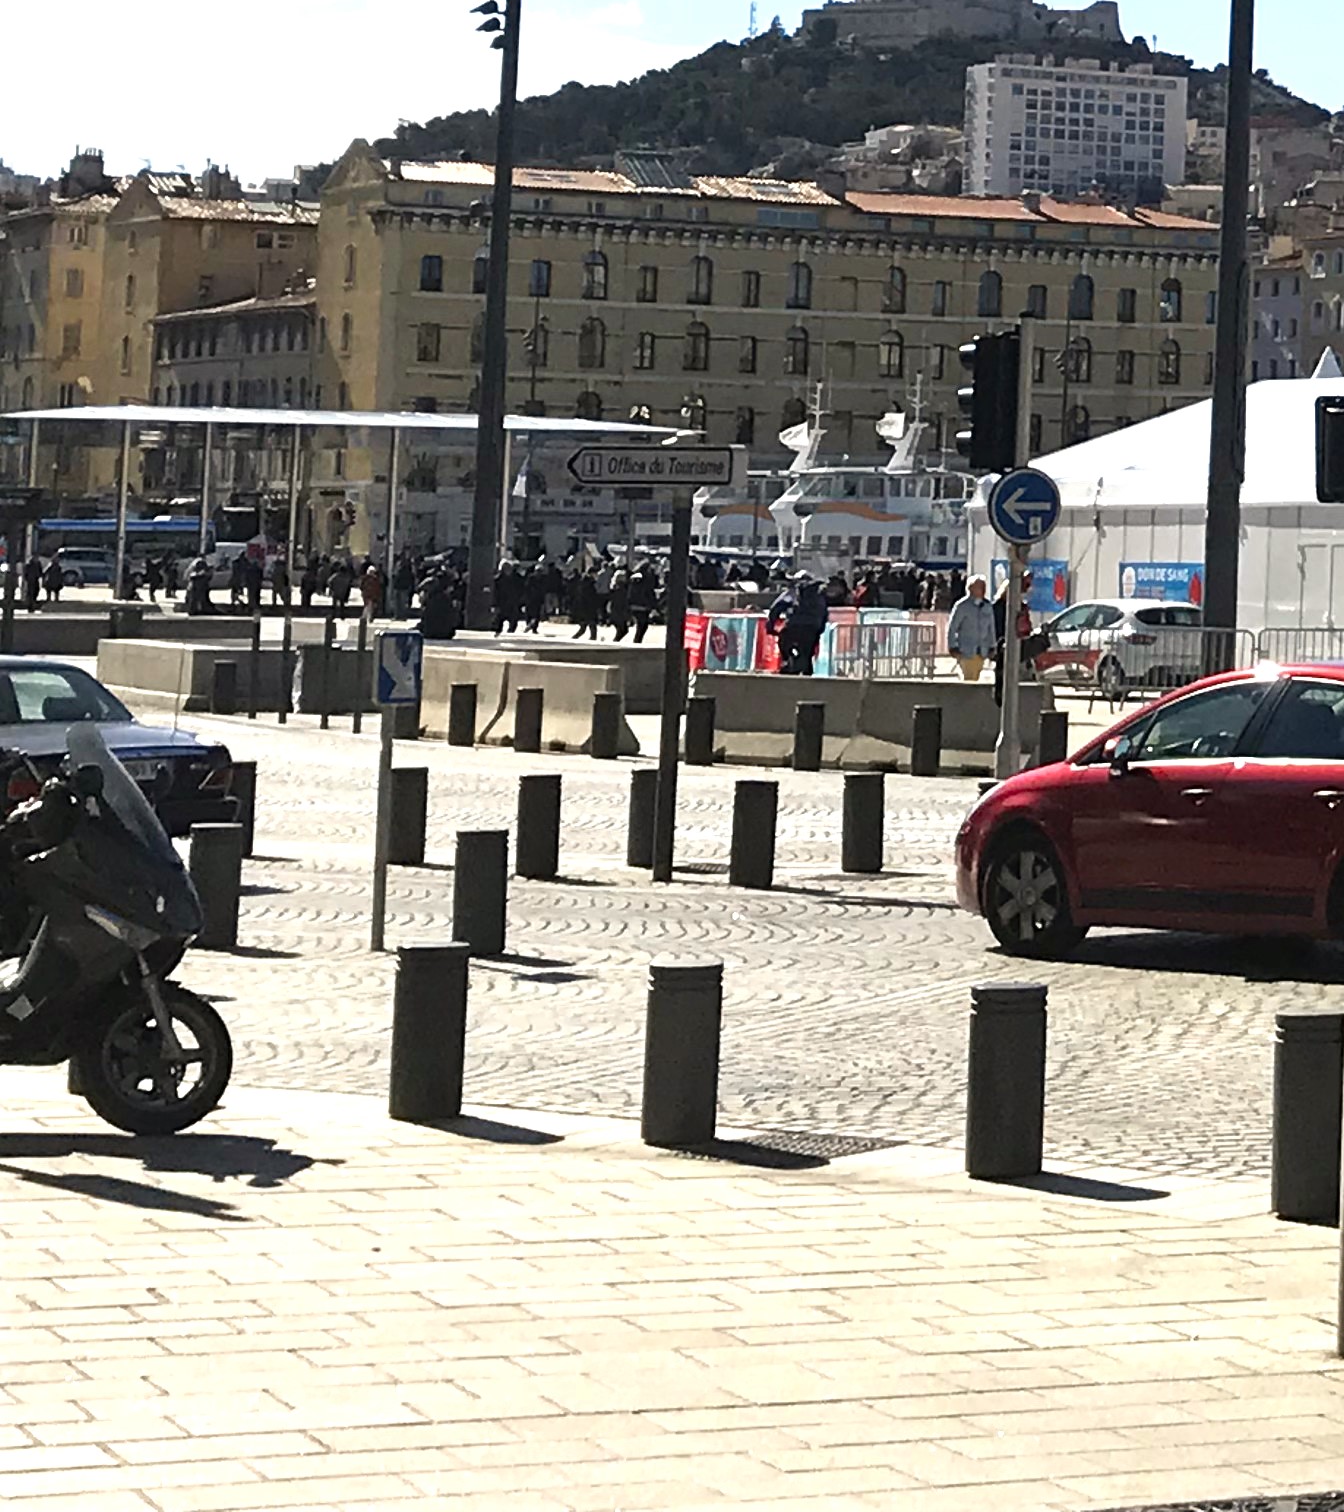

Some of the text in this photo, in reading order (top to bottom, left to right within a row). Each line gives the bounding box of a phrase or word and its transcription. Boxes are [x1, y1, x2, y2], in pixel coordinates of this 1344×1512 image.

[607, 455, 647, 475] Office
[649, 455, 665, 475] du
[668, 455, 726, 475] Tourisme
[1137, 567, 1189, 583] DON DE SANG
